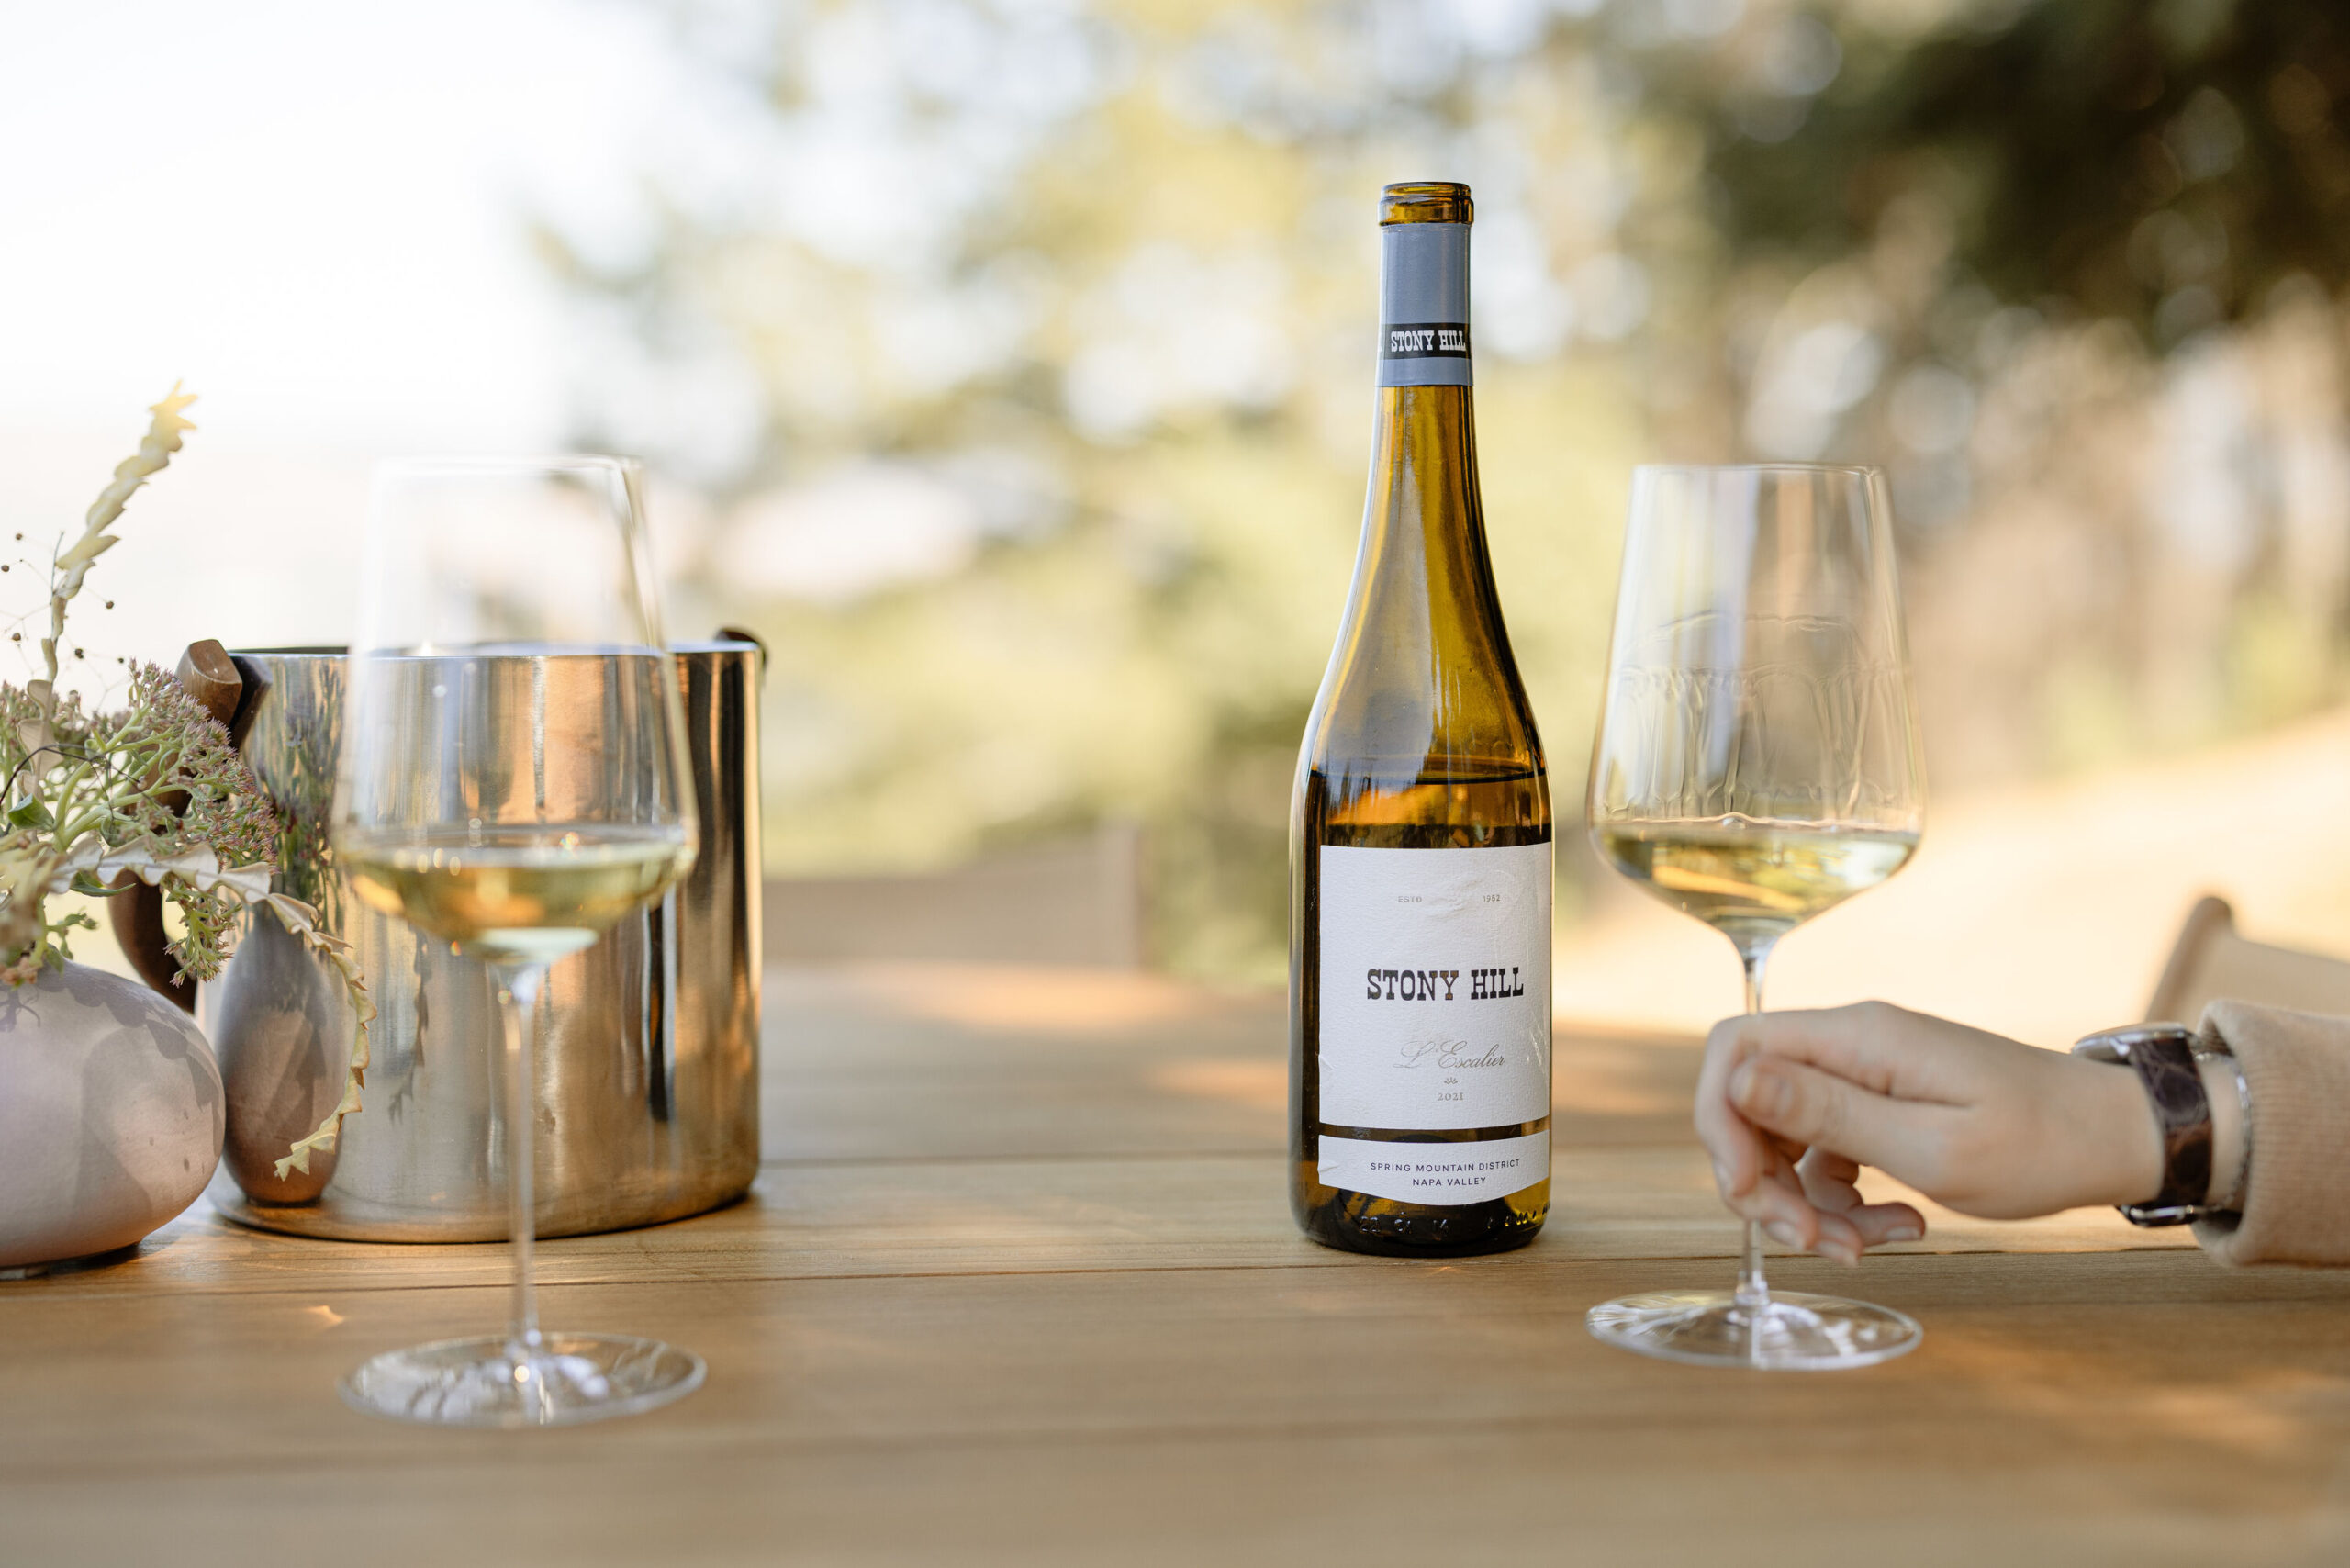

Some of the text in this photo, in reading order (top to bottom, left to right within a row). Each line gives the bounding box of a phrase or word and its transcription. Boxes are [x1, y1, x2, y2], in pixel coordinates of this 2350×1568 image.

[1391, 330, 1434, 352] STONY
[1438, 330, 1466, 351] HILL
[1367, 967, 1524, 1001] STONY HILL
[1393, 1040, 1505, 1069] L'Escalier
[1438, 1092, 1464, 1101] 2021
[1371, 1159, 1520, 1172] SPRING MOUNTAIN DISTRICT
[1448, 1177, 1487, 1186] VALLEY
